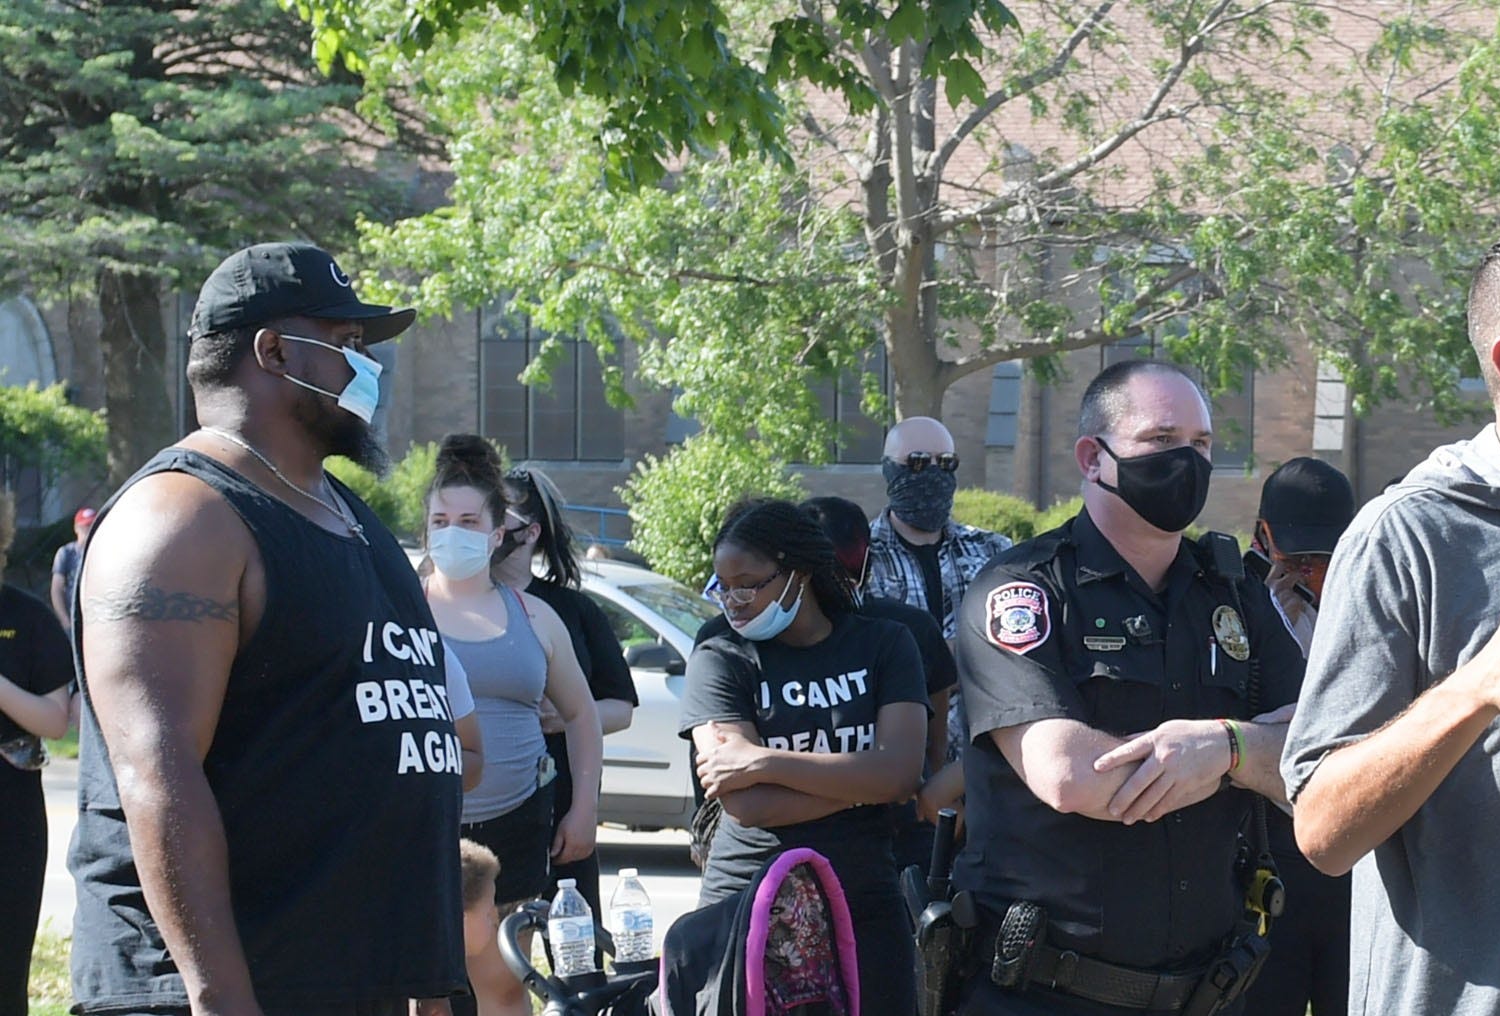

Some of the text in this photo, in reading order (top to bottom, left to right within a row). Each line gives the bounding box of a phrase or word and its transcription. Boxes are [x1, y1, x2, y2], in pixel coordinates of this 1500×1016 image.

[993, 587, 1041, 604] POLICE
[363, 621, 374, 663] I
[760, 668, 868, 709] I CANT
[761, 723, 876, 754] REATH
